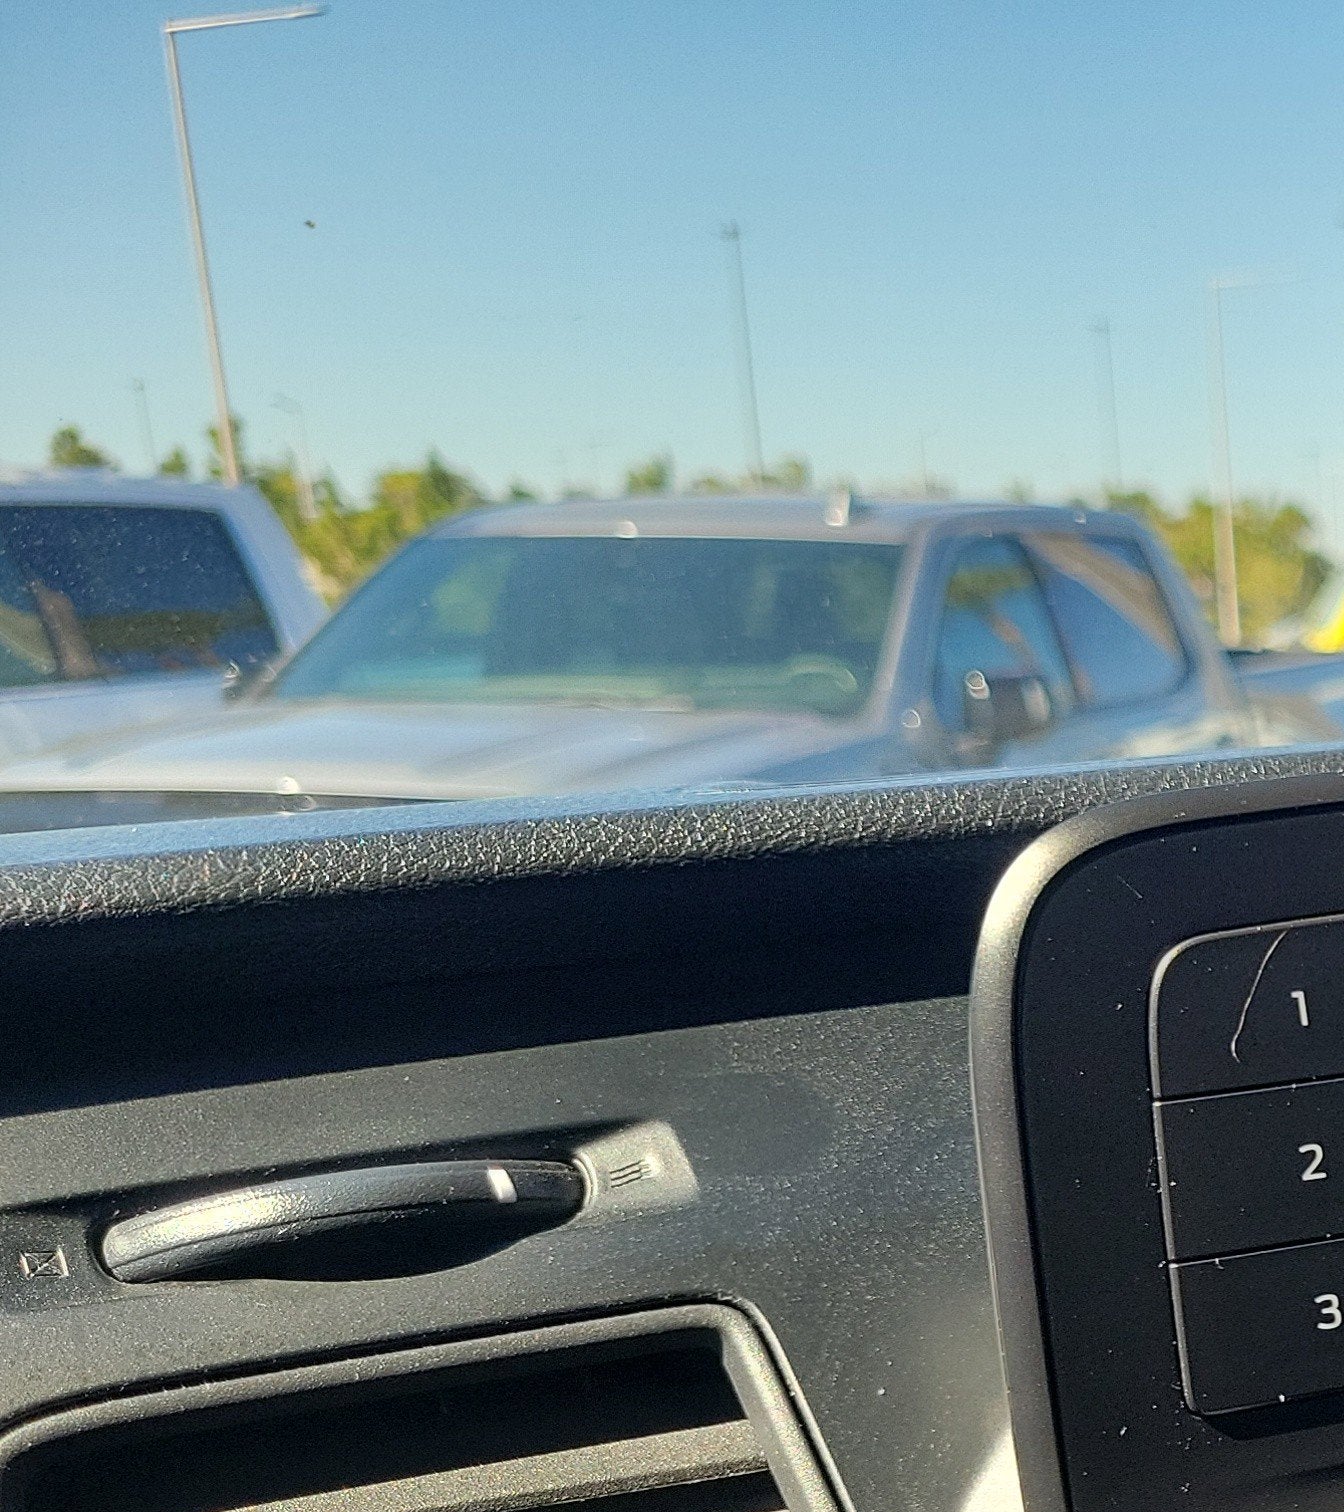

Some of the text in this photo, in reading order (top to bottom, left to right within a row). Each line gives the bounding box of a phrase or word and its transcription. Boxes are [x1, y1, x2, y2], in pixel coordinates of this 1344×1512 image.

[1290, 990, 1309, 1027] 1
[1299, 1144, 1327, 1181] 2
[1314, 1293, 1343, 1330] 3
